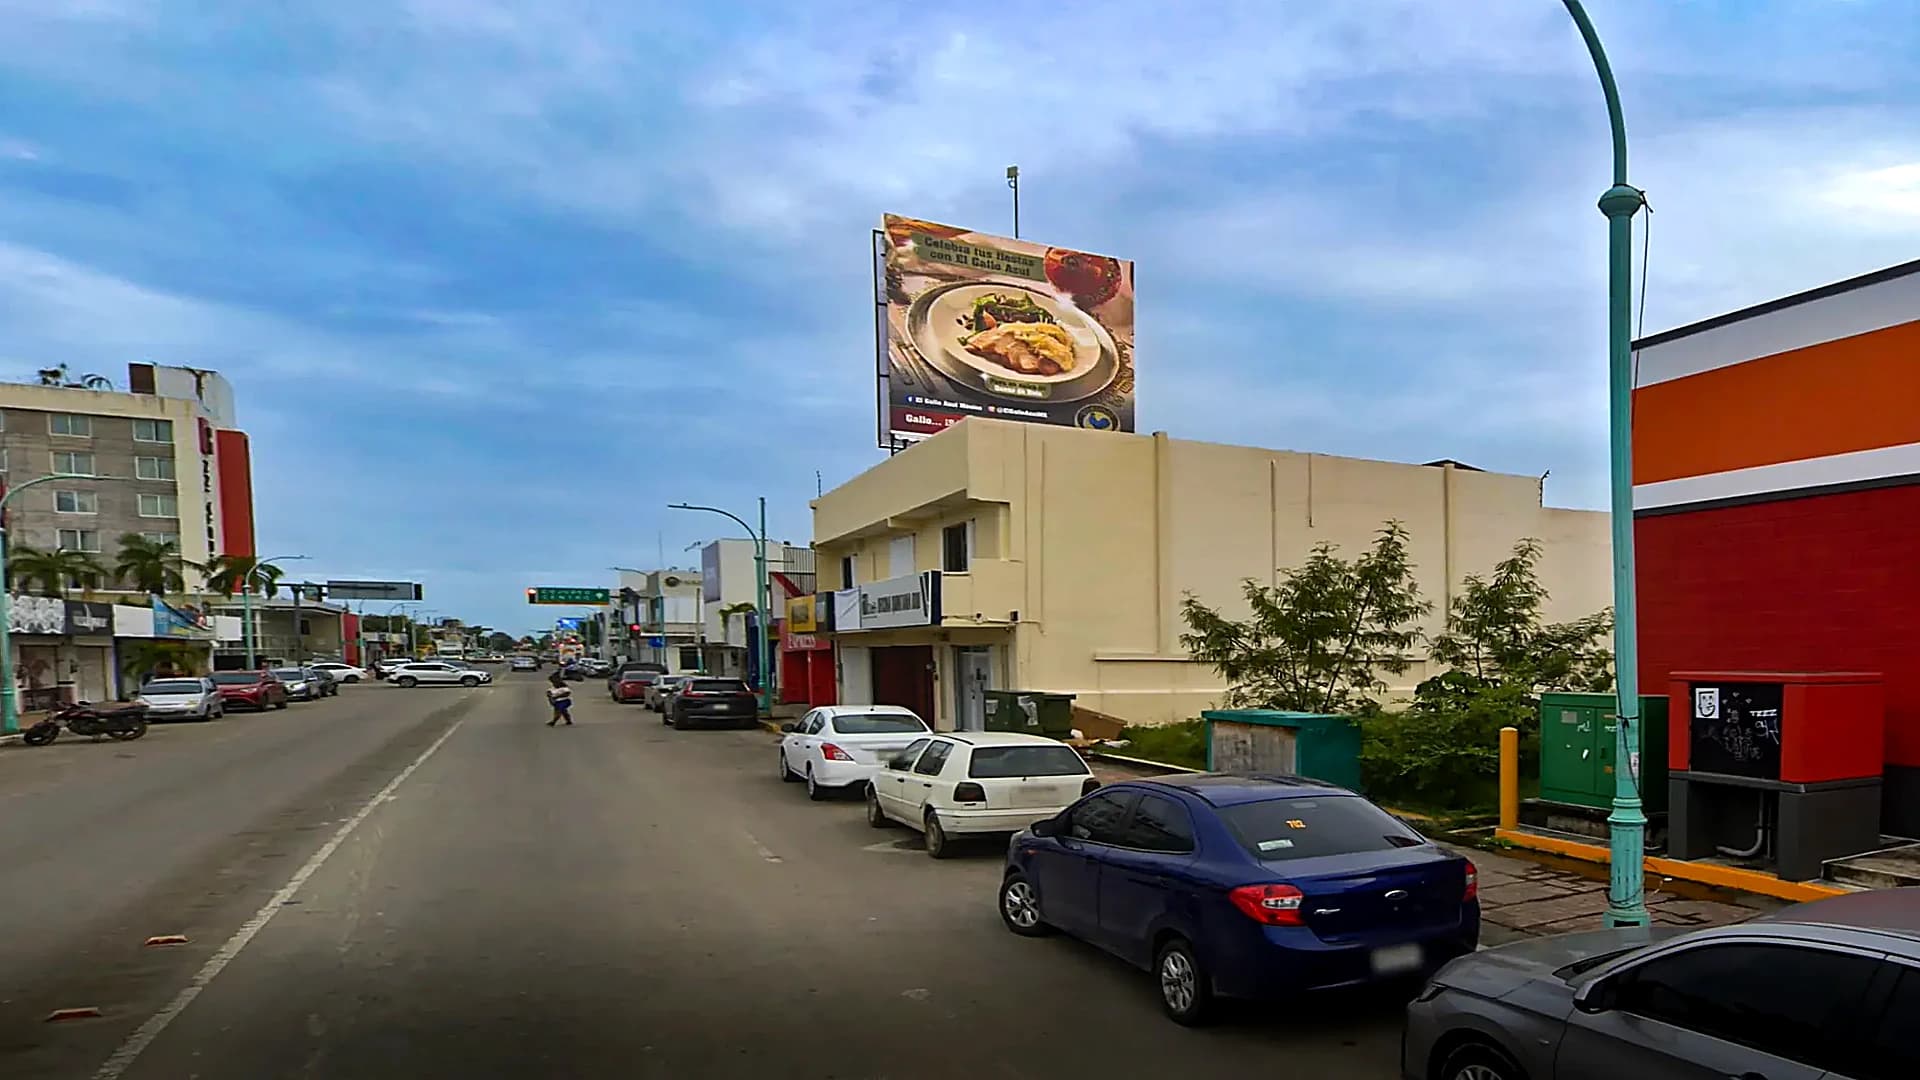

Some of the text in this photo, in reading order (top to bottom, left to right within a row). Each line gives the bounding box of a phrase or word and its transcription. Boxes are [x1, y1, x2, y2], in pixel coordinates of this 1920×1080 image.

[925, 236, 970, 255] Celebra
[975, 247, 992, 259] tus
[930, 251, 1030, 277] con El Gallo Azul
